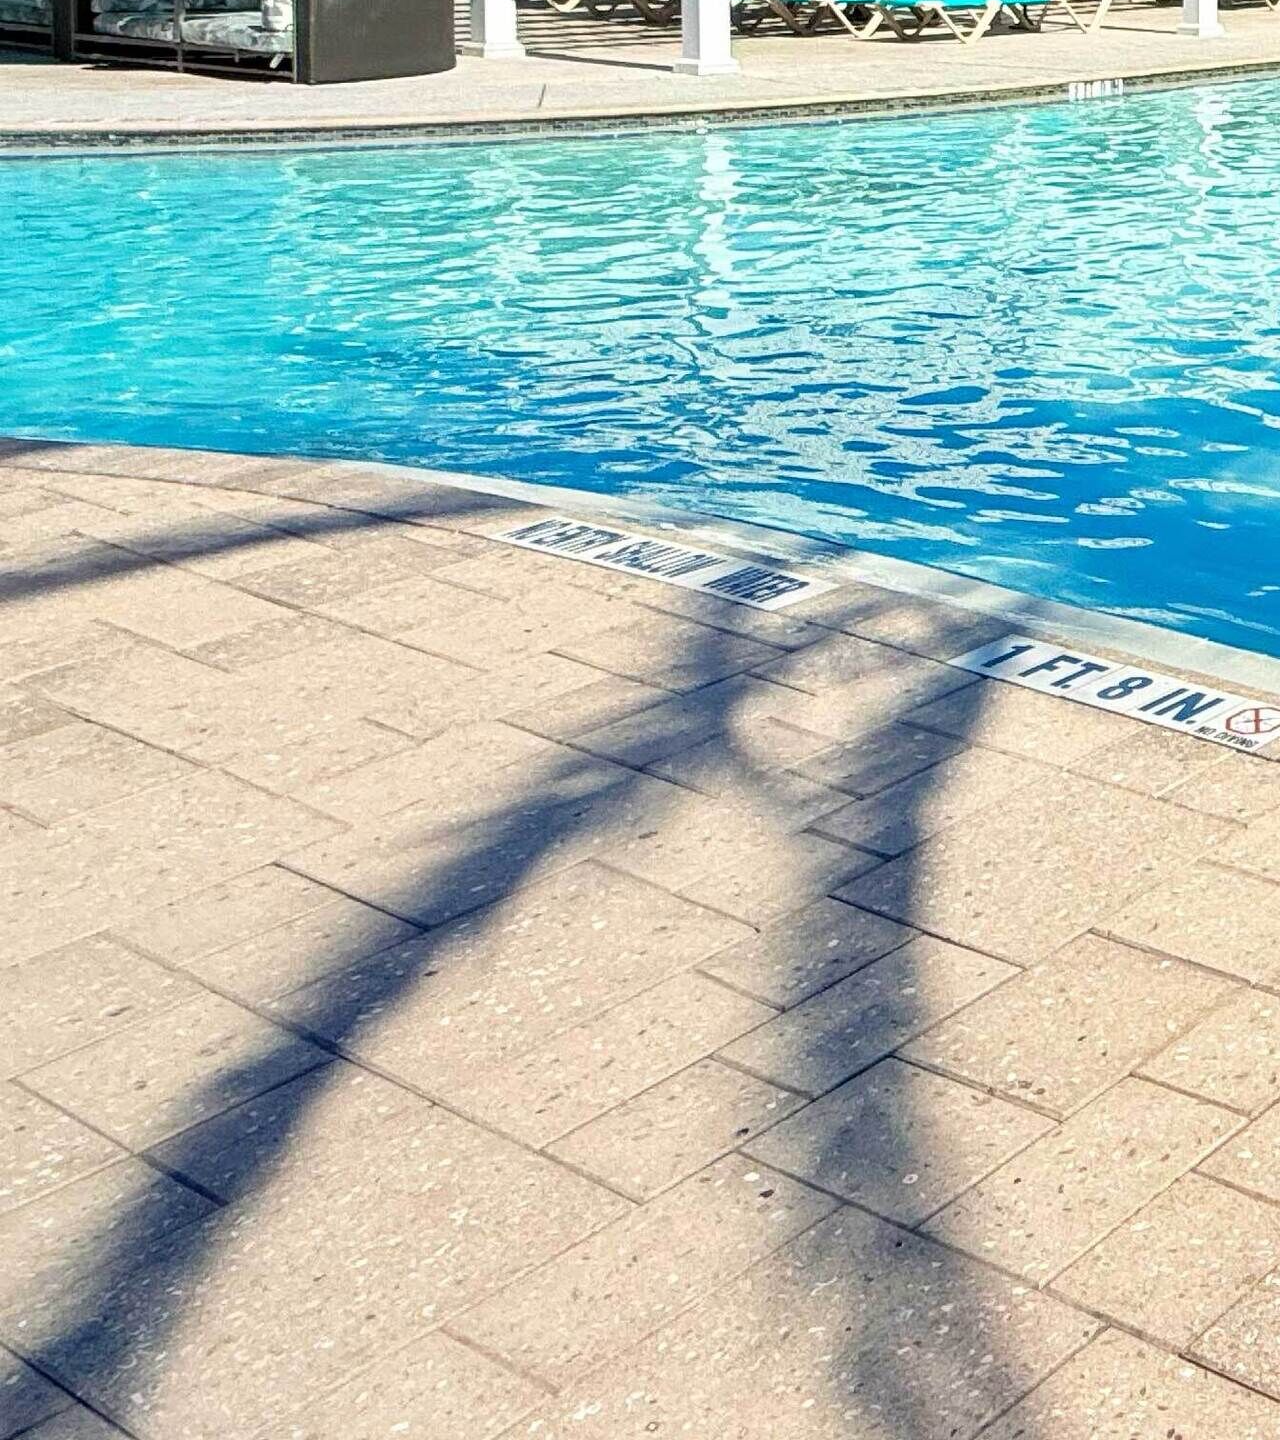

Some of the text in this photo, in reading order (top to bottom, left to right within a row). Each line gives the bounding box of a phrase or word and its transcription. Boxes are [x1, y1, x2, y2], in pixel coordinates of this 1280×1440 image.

[503, 519, 811, 603] NO ENTRY SHALLOW WATER
[981, 644, 1225, 725] 1 FT. 8 IN.
